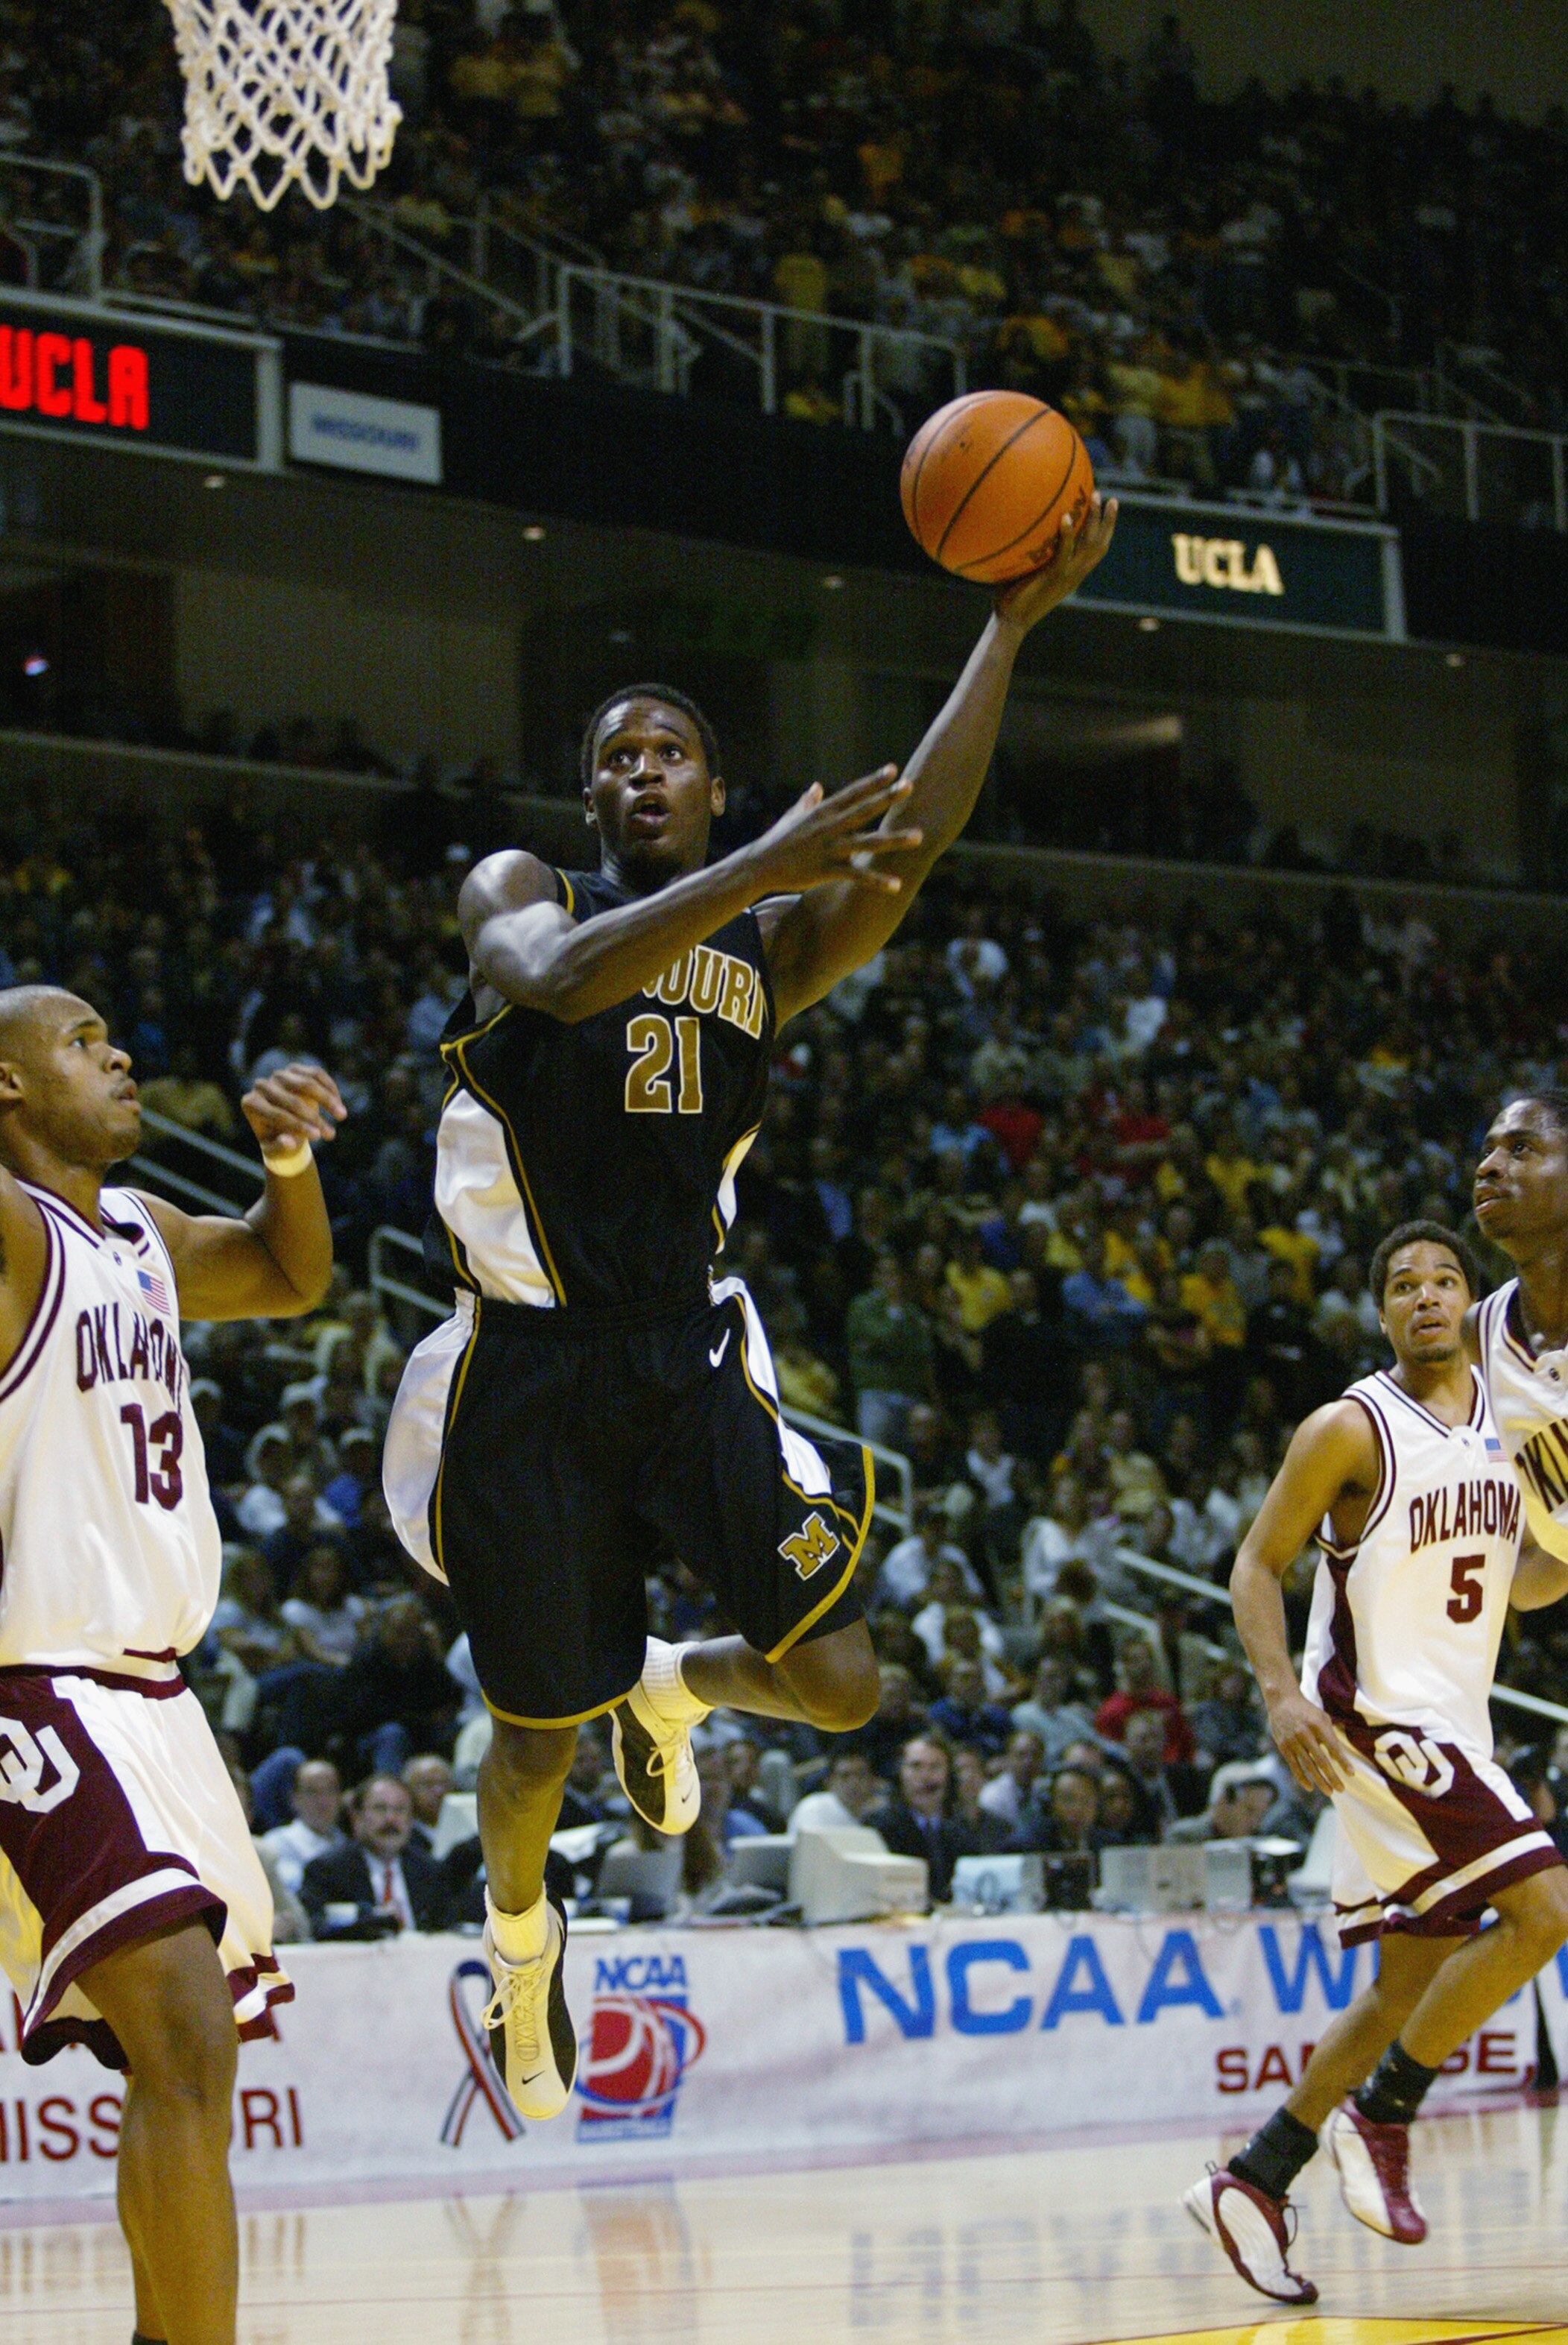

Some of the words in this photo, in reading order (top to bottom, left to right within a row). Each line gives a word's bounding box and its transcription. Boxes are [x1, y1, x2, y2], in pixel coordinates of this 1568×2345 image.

[0, 323, 148, 429] UCLA
[1172, 532, 1285, 596] UCLA
[642, 944, 765, 1040] OURI
[625, 1014, 703, 1113] 21
[120, 1402, 183, 1511] 13
[777, 1511, 840, 1581] M
[1409, 1480, 1521, 1553] OKLAHOMA
[1447, 1554, 1486, 1623] 5
[595, 1955, 687, 1992] NCAA
[837, 1928, 1225, 2045] NCAA
[1215, 2043, 1317, 2094] SA
